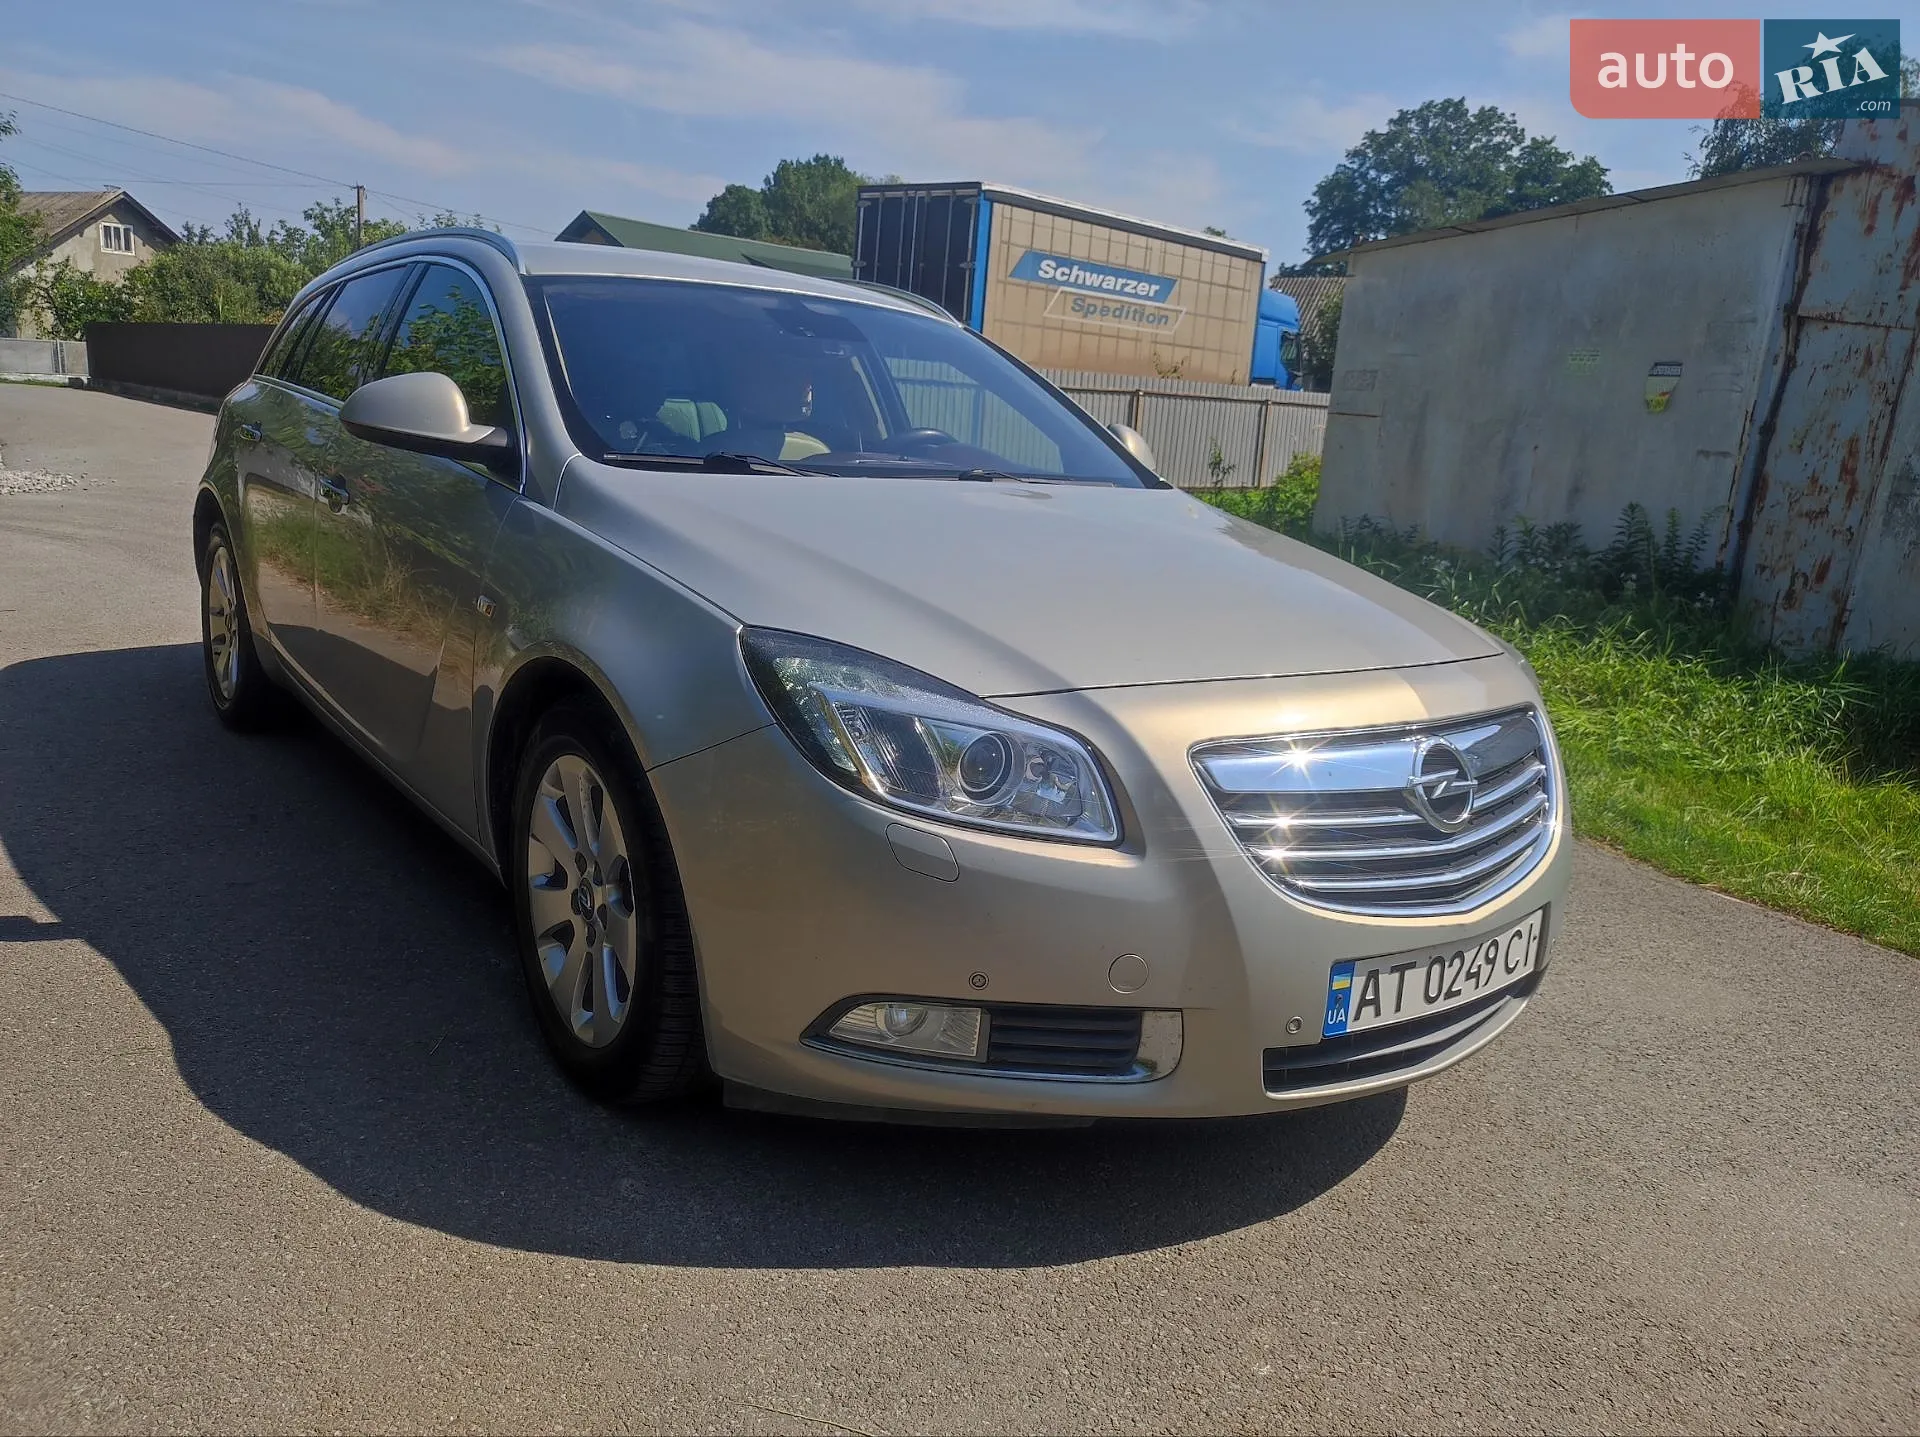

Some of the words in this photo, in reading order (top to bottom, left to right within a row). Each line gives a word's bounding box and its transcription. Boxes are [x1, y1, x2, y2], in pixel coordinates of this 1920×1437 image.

[1038, 259, 1160, 298] Schwarzer
[1071, 297, 1169, 326] Spedition
[1352, 961, 1417, 1022] AT
[1423, 937, 1499, 1005] 0249
[1504, 922, 1533, 975] CI
[1327, 1009, 1346, 1025] UA
